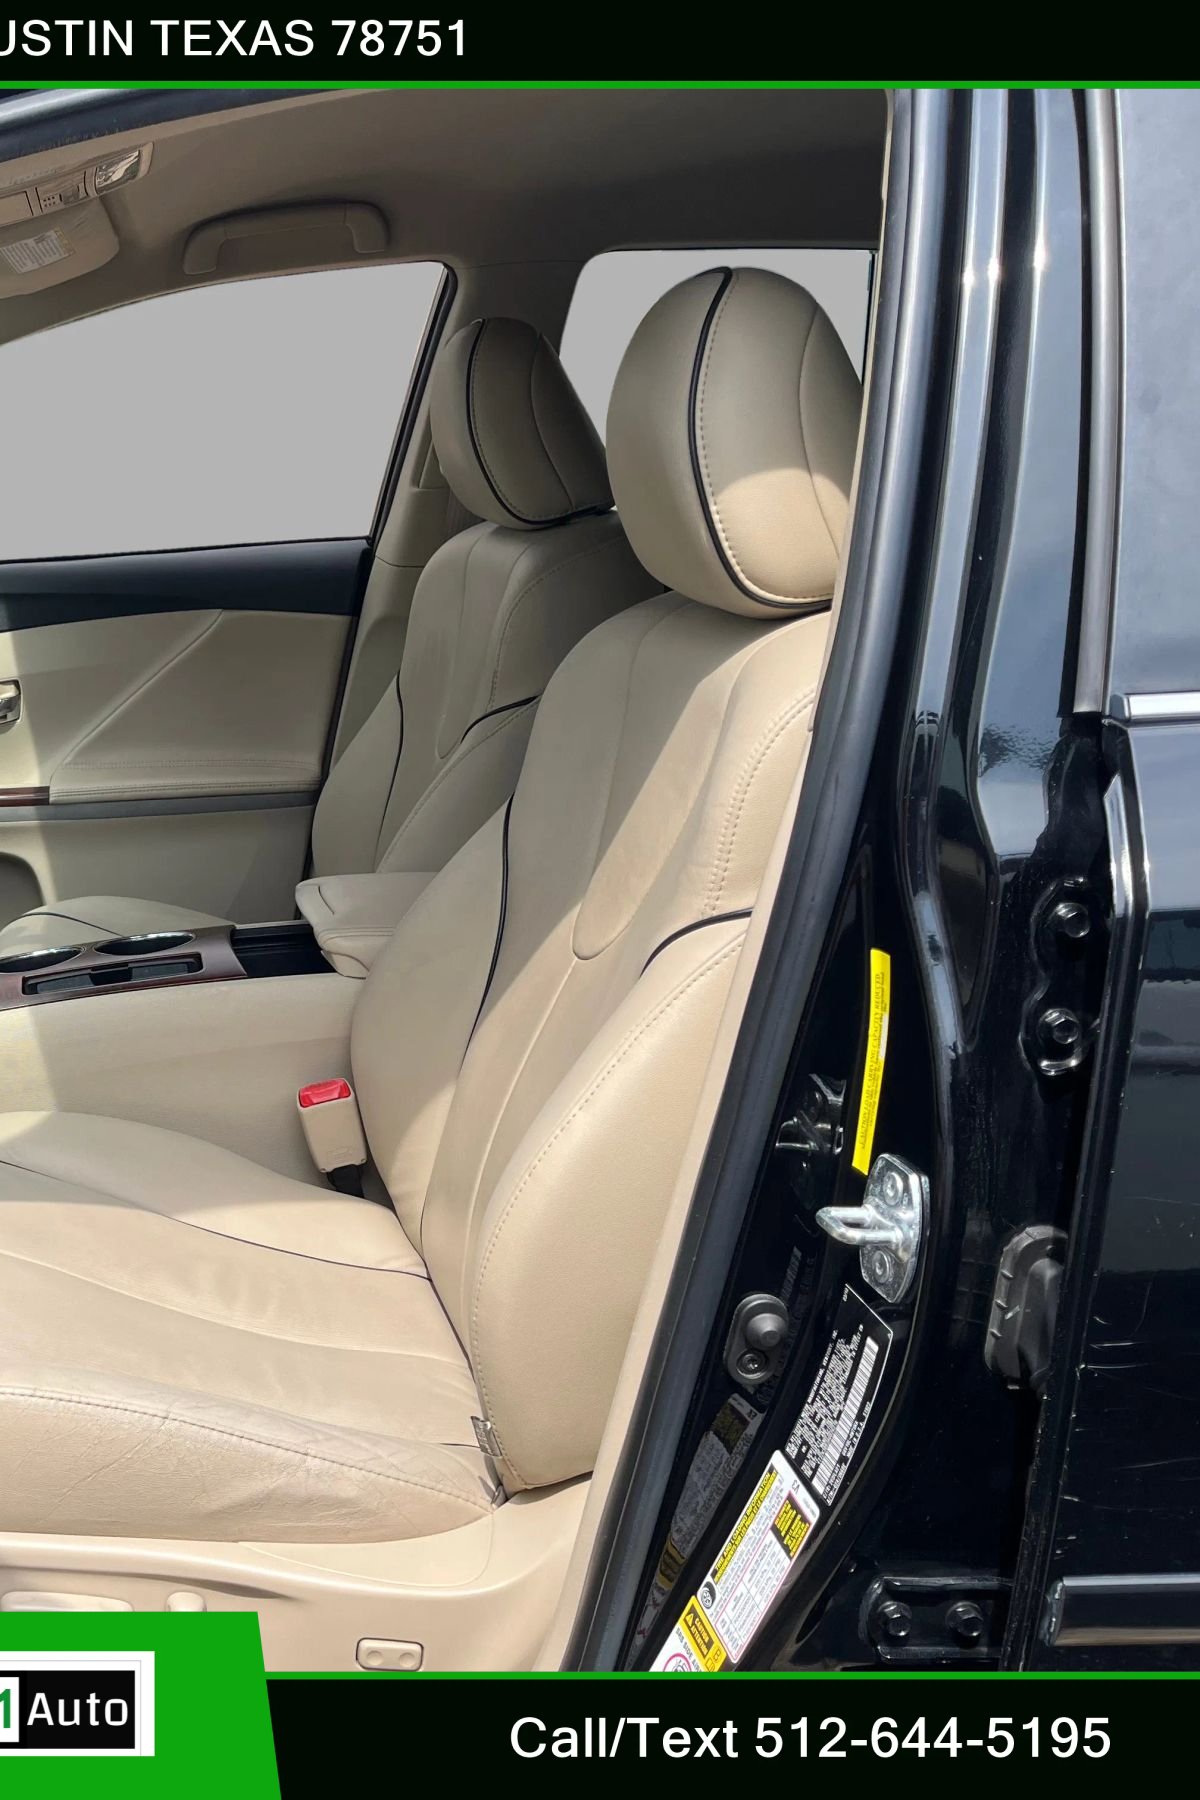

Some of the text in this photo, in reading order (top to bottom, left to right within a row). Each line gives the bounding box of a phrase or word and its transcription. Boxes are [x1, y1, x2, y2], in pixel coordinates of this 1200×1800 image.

[675, 1627, 684, 1643] SRS
[683, 1641, 693, 1659] SIDE
[691, 1625, 709, 1654] ATTENTION
[694, 1617, 709, 1643] CAUTION
